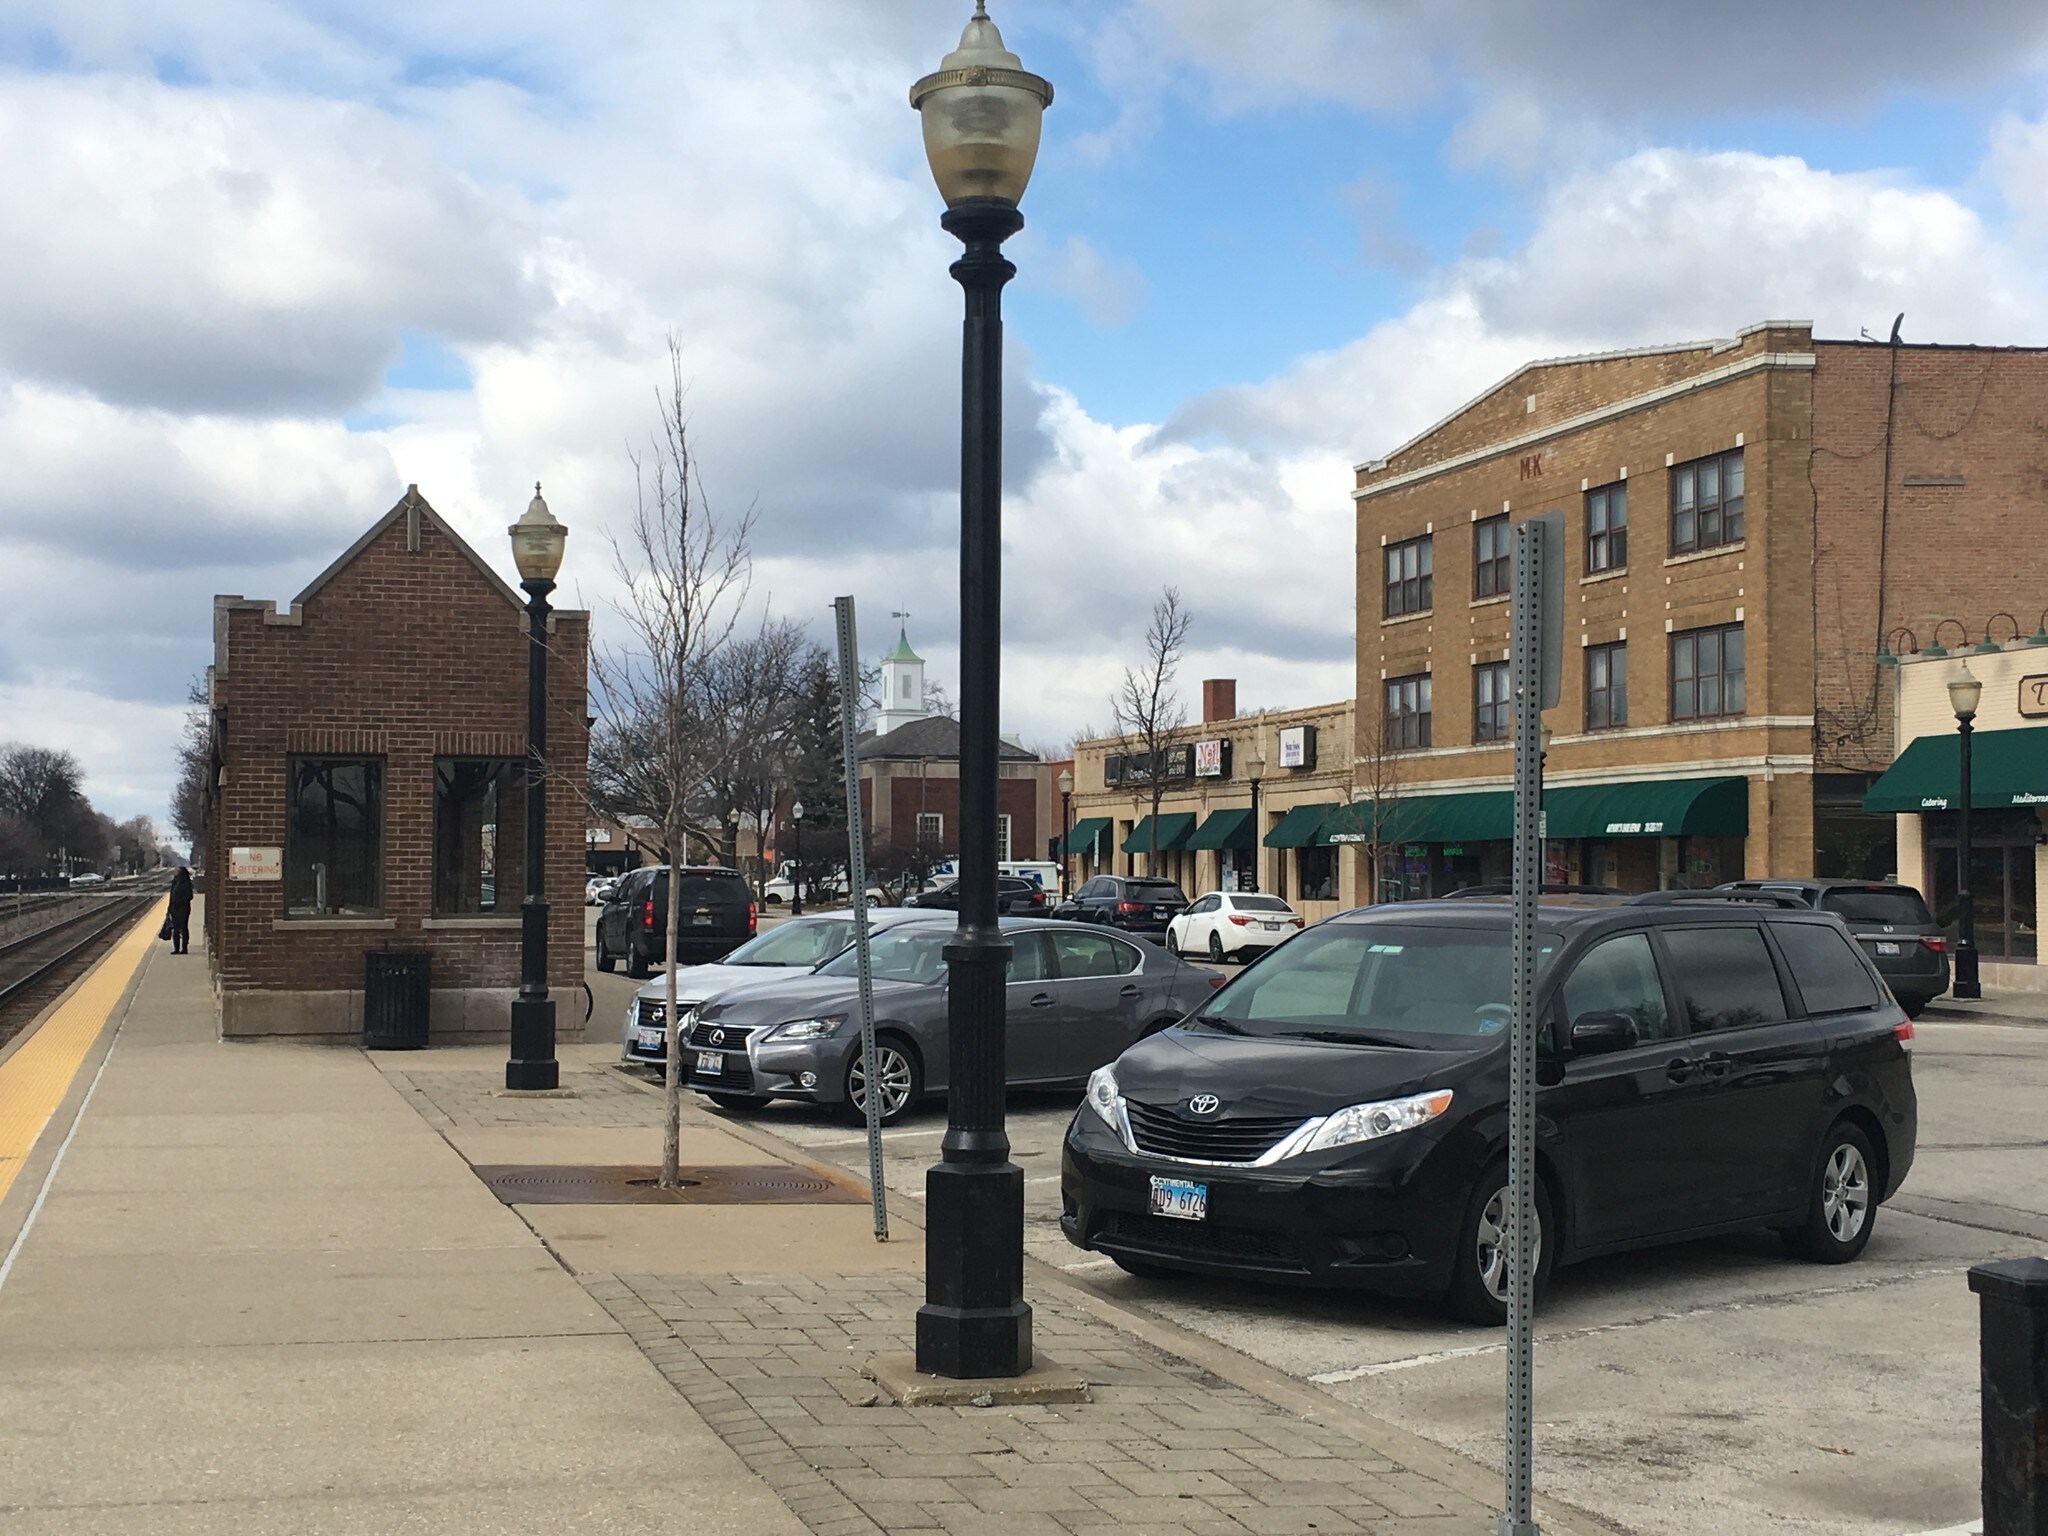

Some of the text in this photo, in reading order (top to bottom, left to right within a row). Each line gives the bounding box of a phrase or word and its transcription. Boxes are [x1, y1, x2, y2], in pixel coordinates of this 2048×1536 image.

[1921, 797, 1947, 809] Catering
[250, 853, 262, 862] NO
[232, 865, 279, 875] LOITERING
